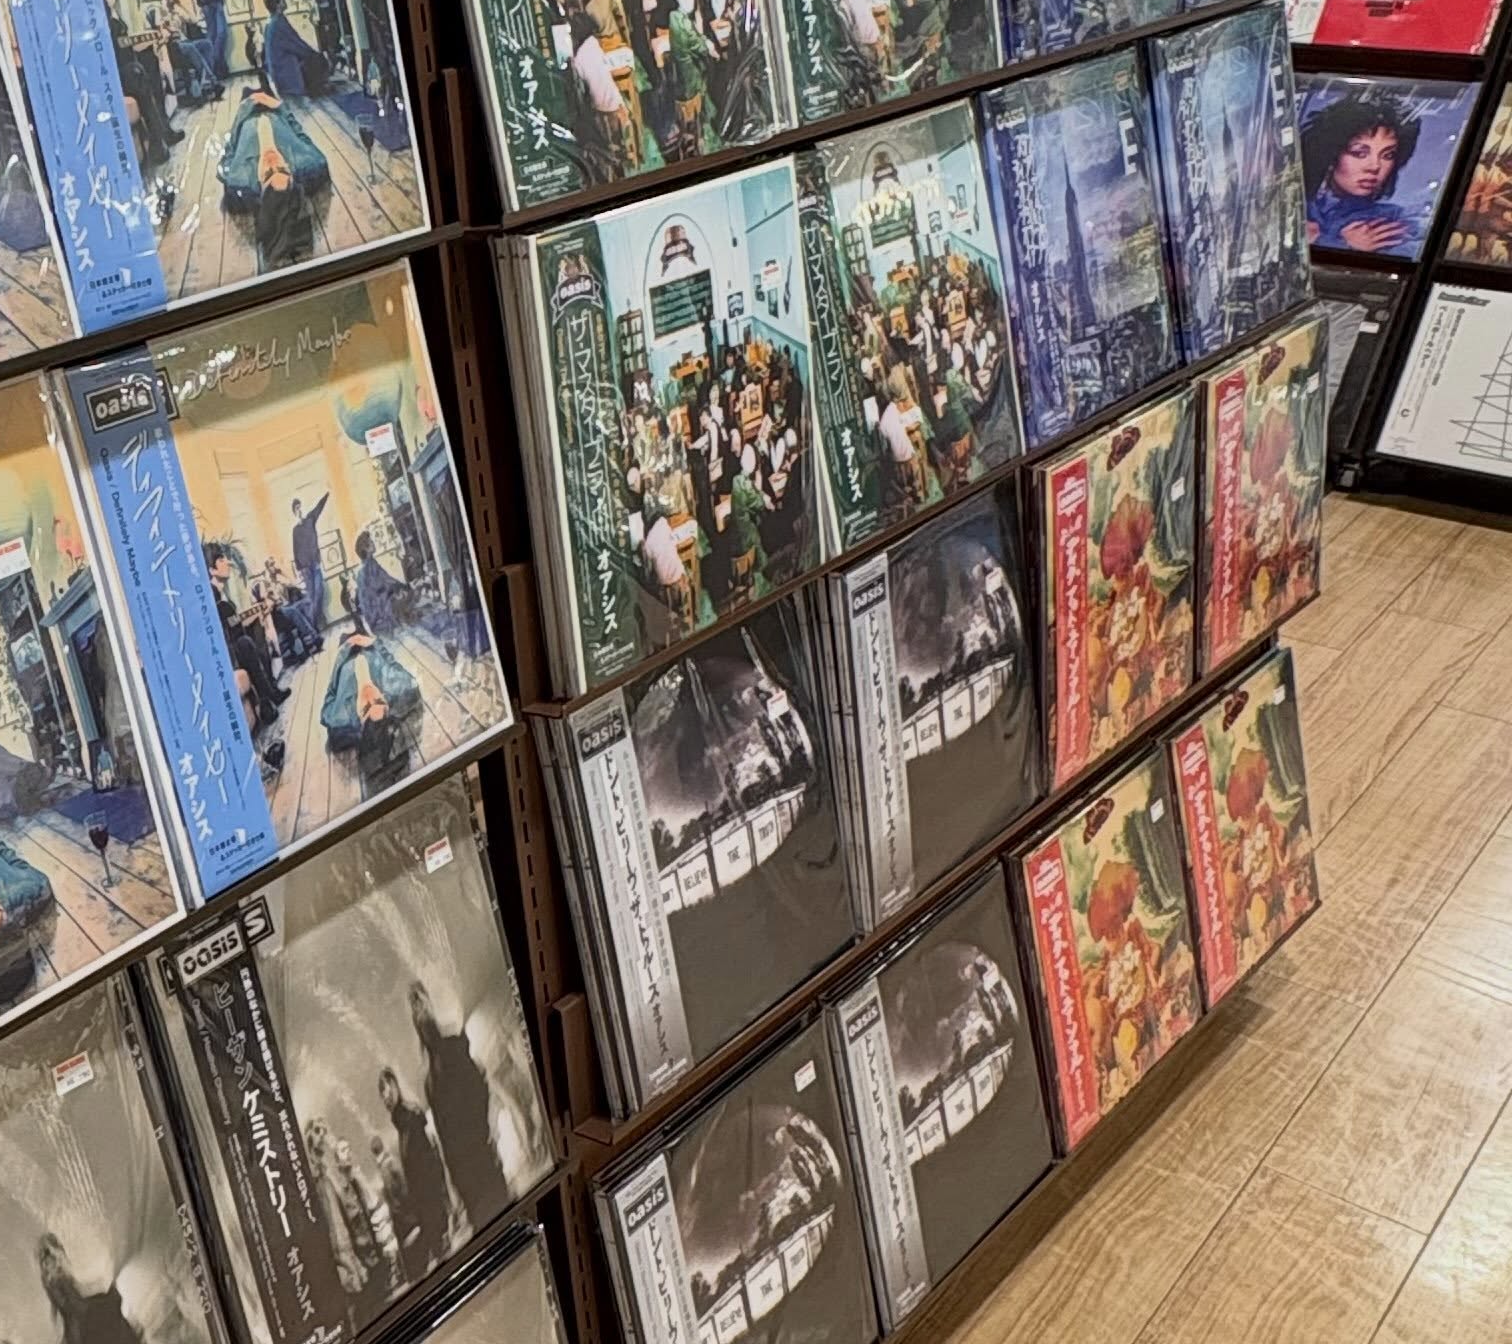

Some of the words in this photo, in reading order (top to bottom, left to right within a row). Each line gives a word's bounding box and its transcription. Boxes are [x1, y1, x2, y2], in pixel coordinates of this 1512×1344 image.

[59, 171, 94, 273] オアシス
[298, 326, 352, 361] Maybe
[95, 389, 150, 420] oasis
[841, 428, 863, 503] オアシス
[597, 549, 618, 634] オアシス
[581, 715, 625, 755] oasis
[179, 752, 214, 842] オアシス
[182, 929, 239, 976] oasis
[627, 1185, 665, 1228] oasis
